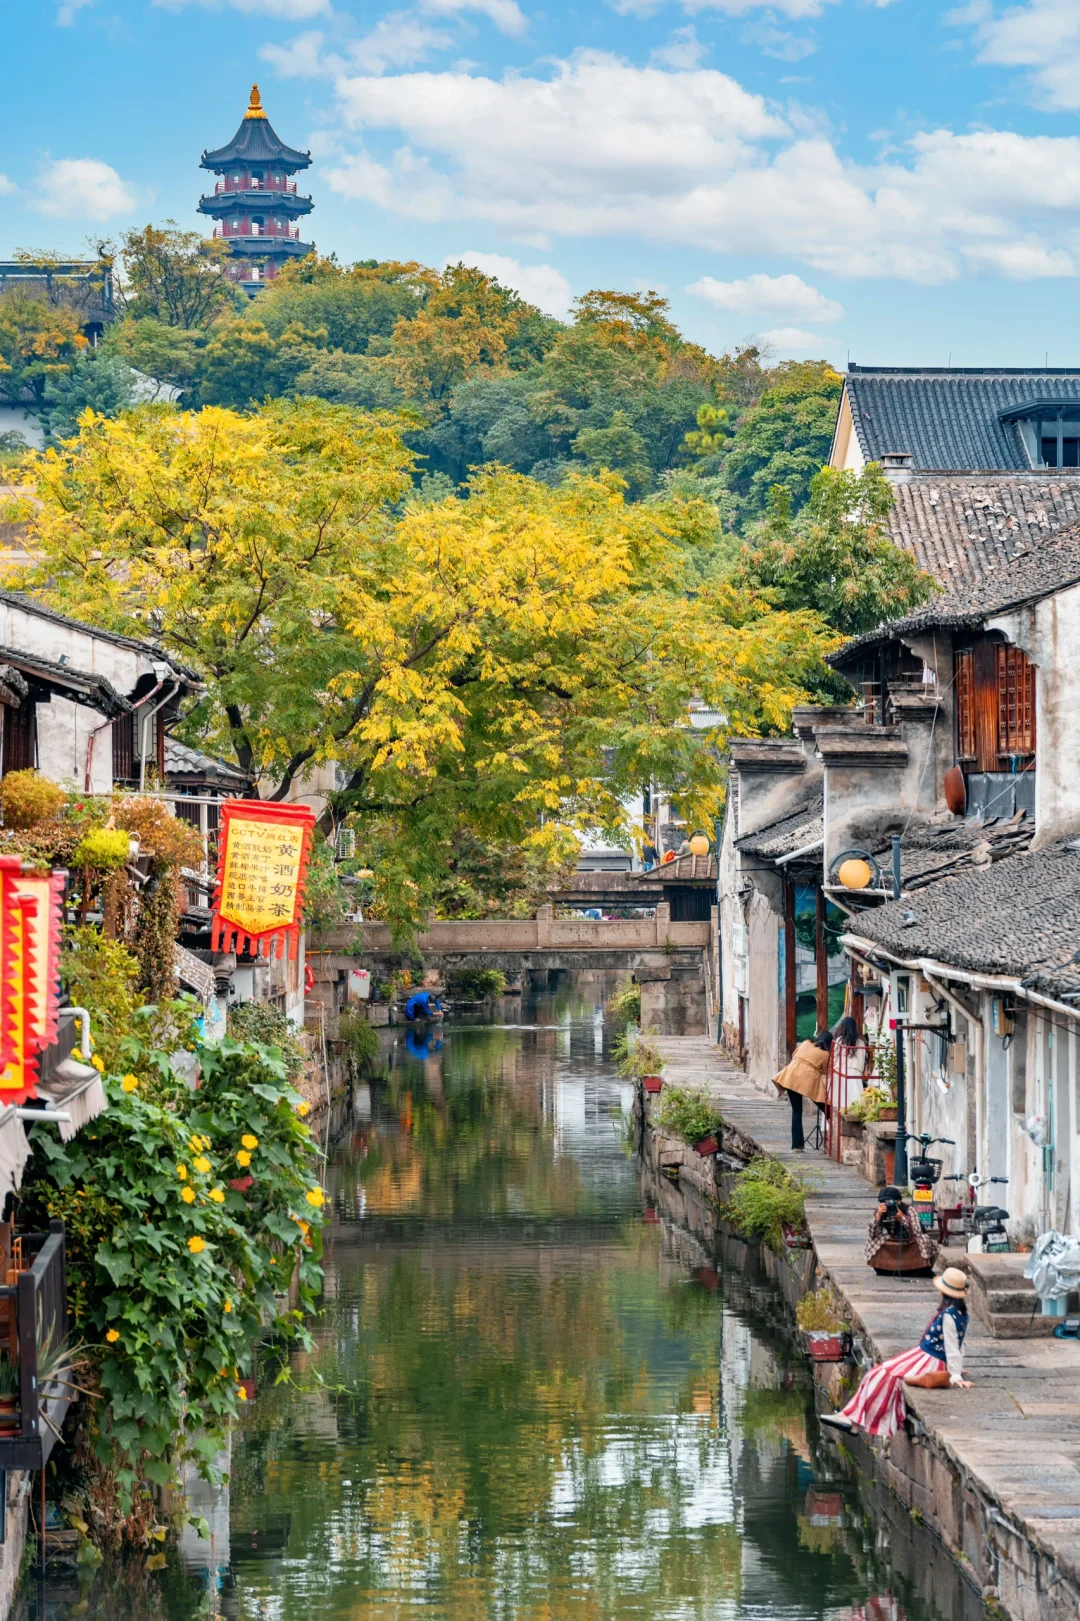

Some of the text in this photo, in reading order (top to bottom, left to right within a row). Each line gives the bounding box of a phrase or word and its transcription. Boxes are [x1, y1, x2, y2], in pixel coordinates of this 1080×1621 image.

[232, 842, 272, 853] 黄酒酸奶
[231, 852, 271, 863] 黄酒布丁
[268, 844, 298, 917] 黄酒奶茶
